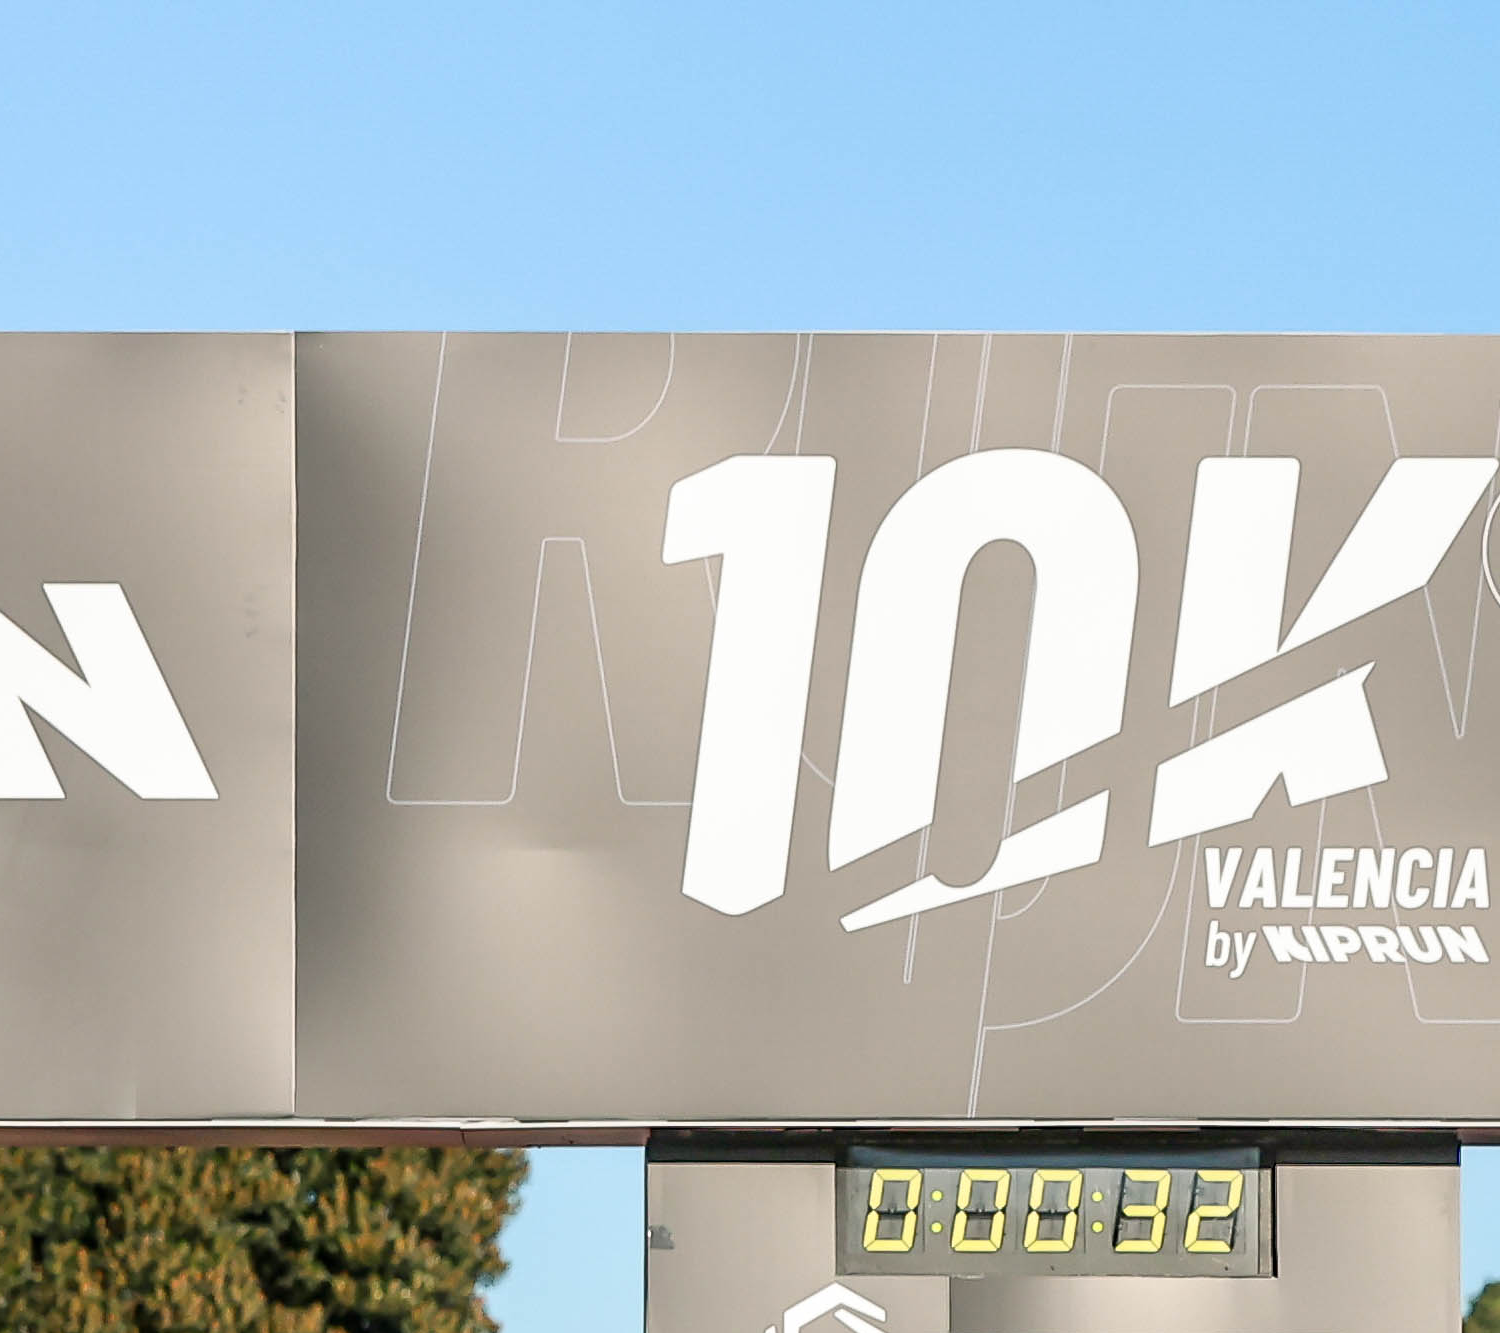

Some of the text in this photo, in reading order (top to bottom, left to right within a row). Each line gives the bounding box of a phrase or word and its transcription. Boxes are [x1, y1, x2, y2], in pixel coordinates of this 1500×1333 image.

[660, 444, 1500, 933] 10K
[1203, 847, 1491, 910] VALENCIA
[1204, 920, 1491, 979] by KIPRUN
[862, 1169, 1244, 1253] 0:00:32
